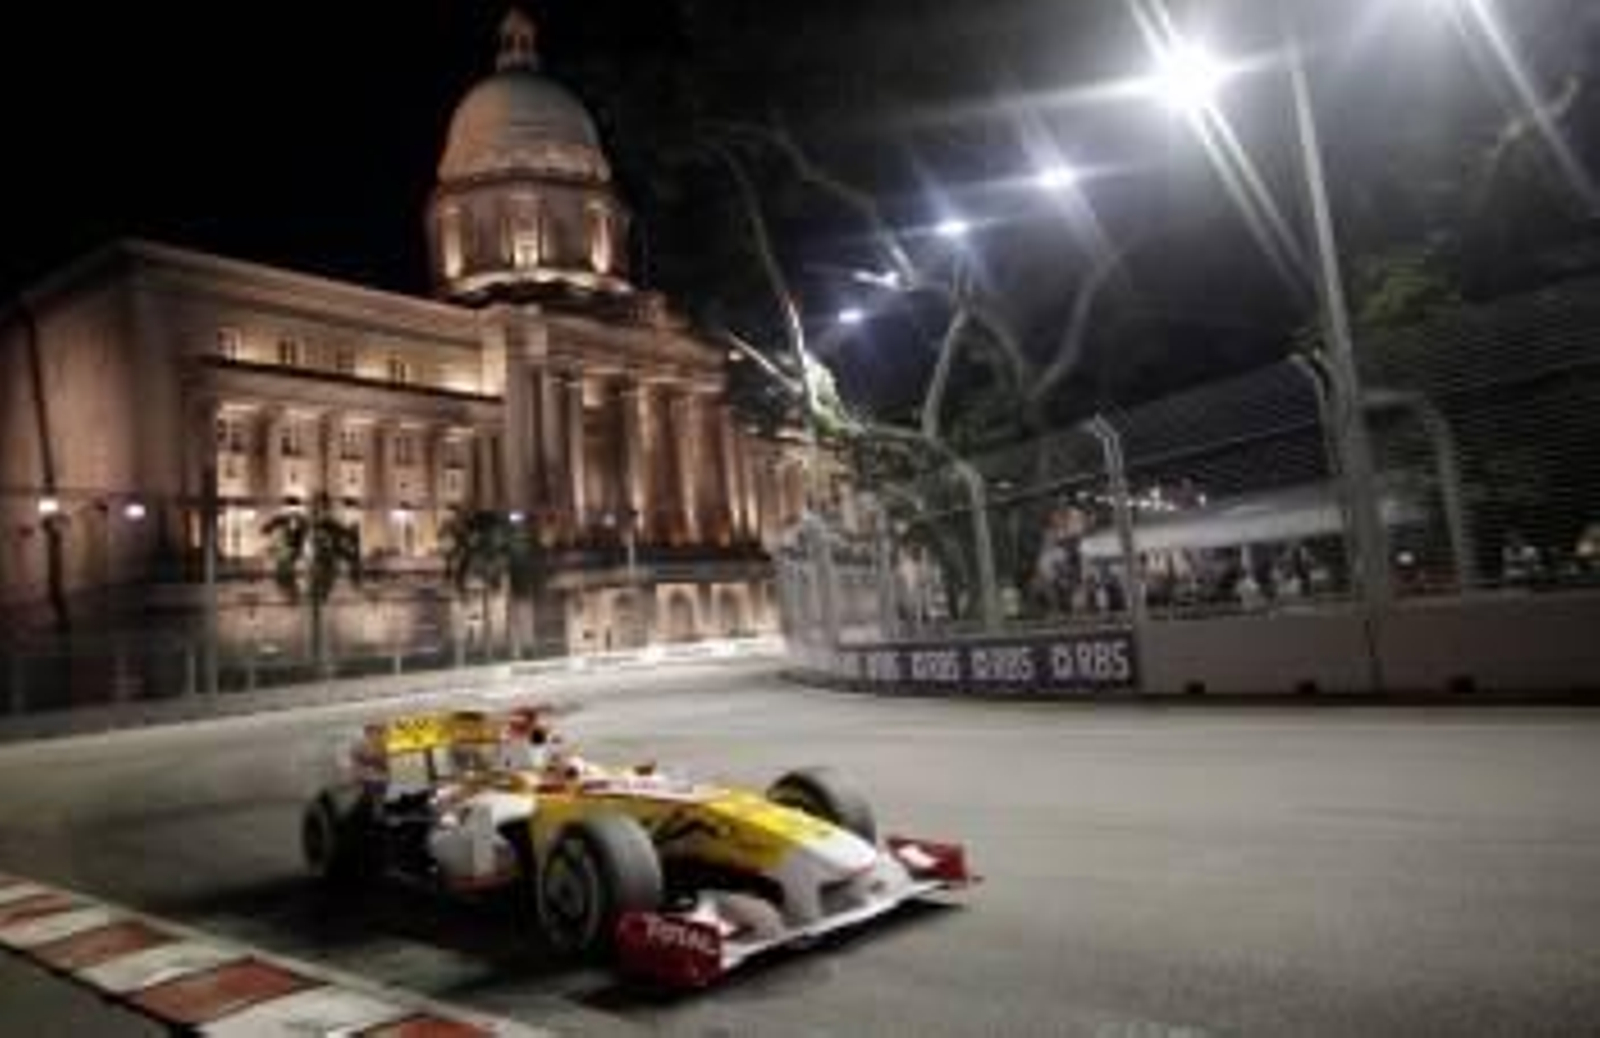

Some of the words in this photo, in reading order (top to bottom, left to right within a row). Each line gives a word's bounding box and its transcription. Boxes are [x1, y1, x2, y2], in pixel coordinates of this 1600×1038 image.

[988, 648, 1034, 679] RBS
[1076, 641, 1129, 678] RBS
[643, 916, 719, 955] TOTAL
